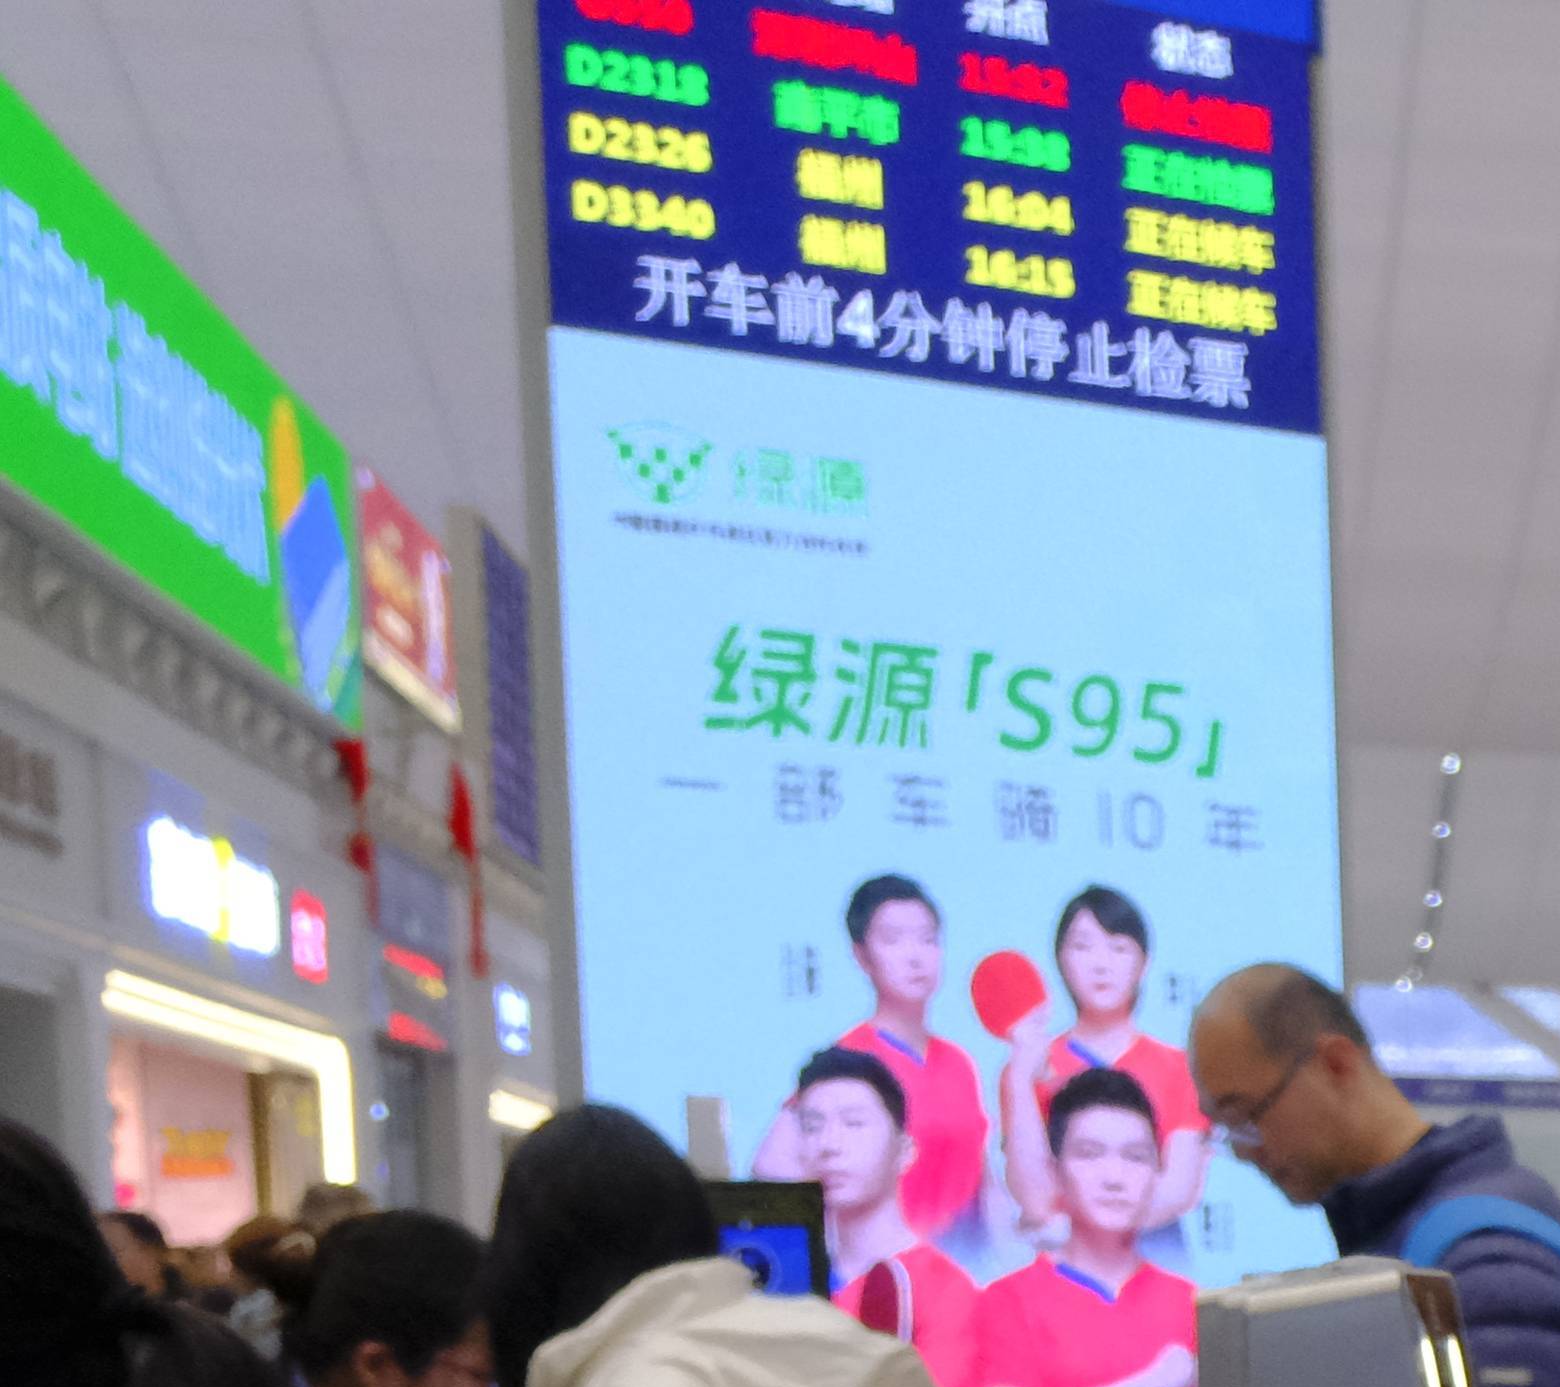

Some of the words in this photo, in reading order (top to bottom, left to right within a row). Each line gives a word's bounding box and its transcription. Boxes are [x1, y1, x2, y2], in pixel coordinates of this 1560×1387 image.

[571, 180, 715, 240] D3340
[1127, 267, 1277, 336] 正在候车
[1125, 207, 1275, 276] 正在候车
[633, 254, 1252, 410] 开车前4分钟停止检票
